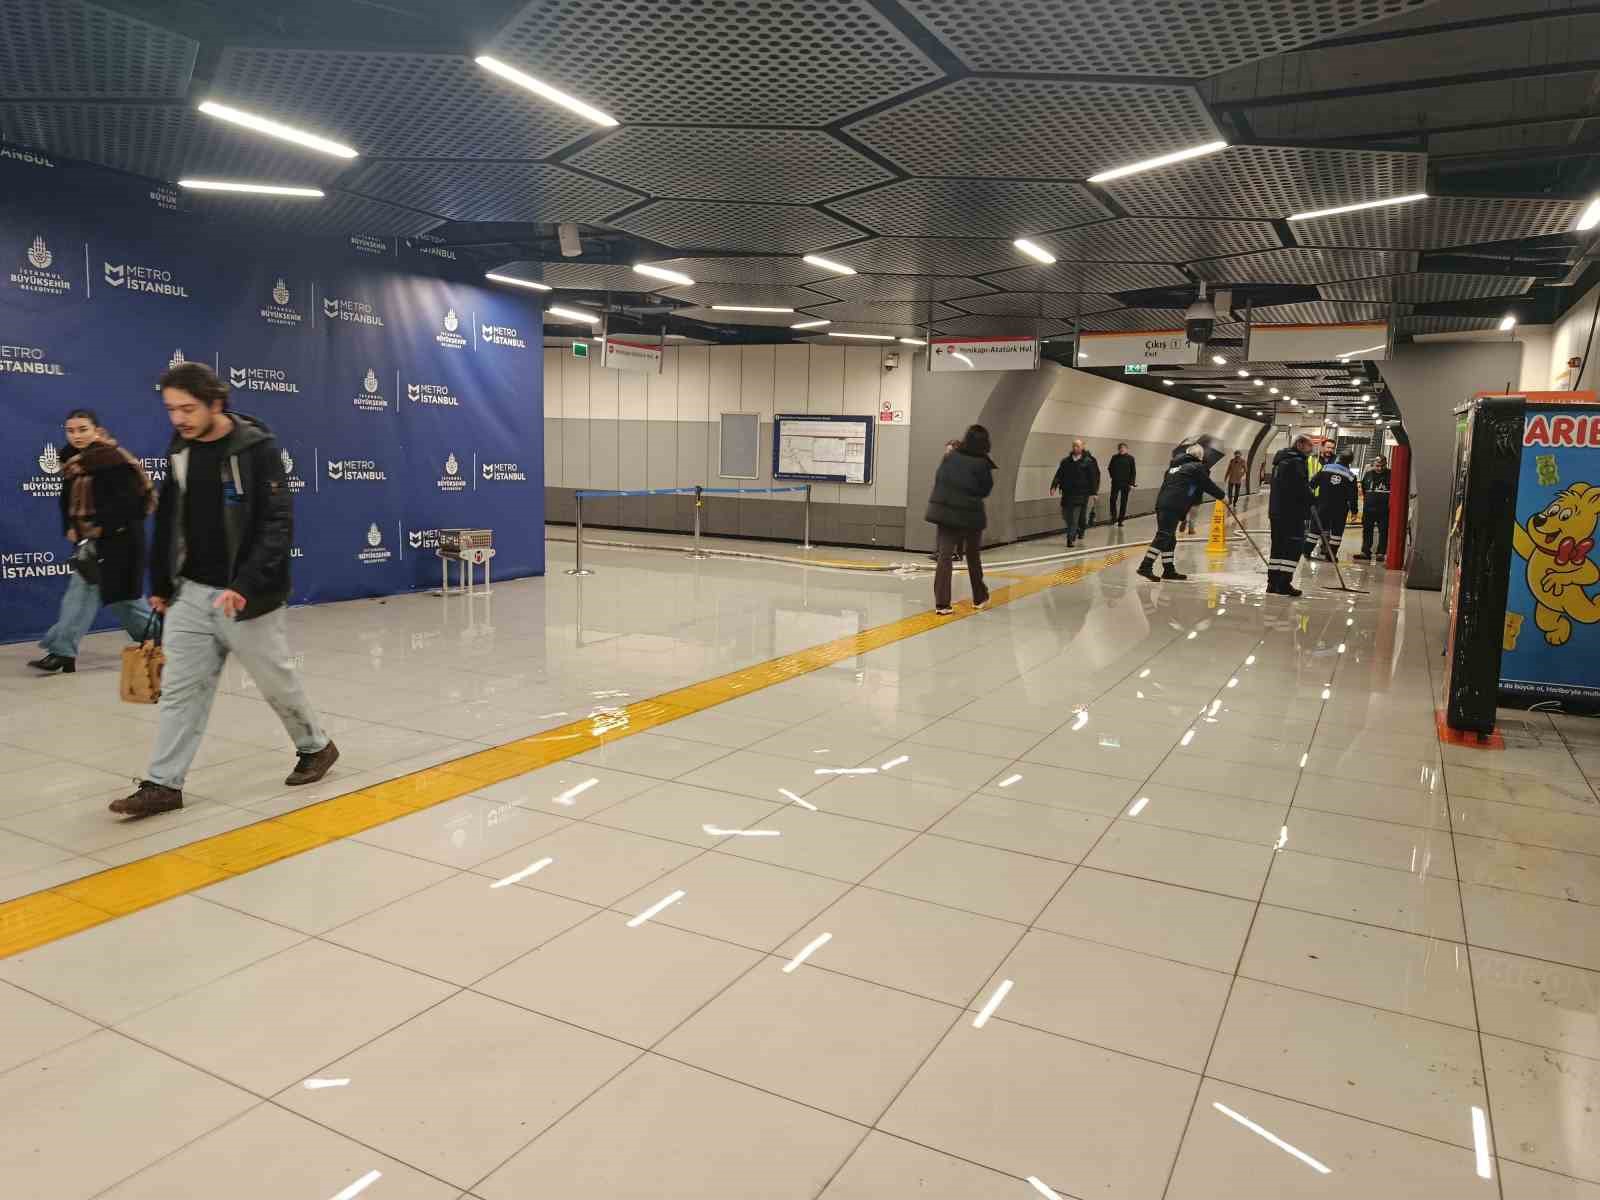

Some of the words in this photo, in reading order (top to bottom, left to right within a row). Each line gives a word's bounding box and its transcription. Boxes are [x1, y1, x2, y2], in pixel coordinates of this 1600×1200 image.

[126, 264, 171, 283] METRO
[127, 277, 190, 298] İSTANBUL
[340, 299, 373, 313] METRO
[340, 311, 384, 327] İSTANBUL
[493, 326, 517, 337] METRO
[493, 336, 527, 348] İSTANBUL
[248, 368, 286, 380] METRO
[248, 378, 300, 393] İSTANBUL
[420, 384, 448, 394] METRO
[420, 393, 459, 406] İSTANBUL
[343, 460, 375, 470] METRO
[493, 463, 518, 472] METRO
[343, 469, 387, 481] İSTANBUL
[493, 471, 526, 481] İSTANBUL
[1, 551, 55, 565] METRO
[2, 564, 75, 579] İSTANBUL
